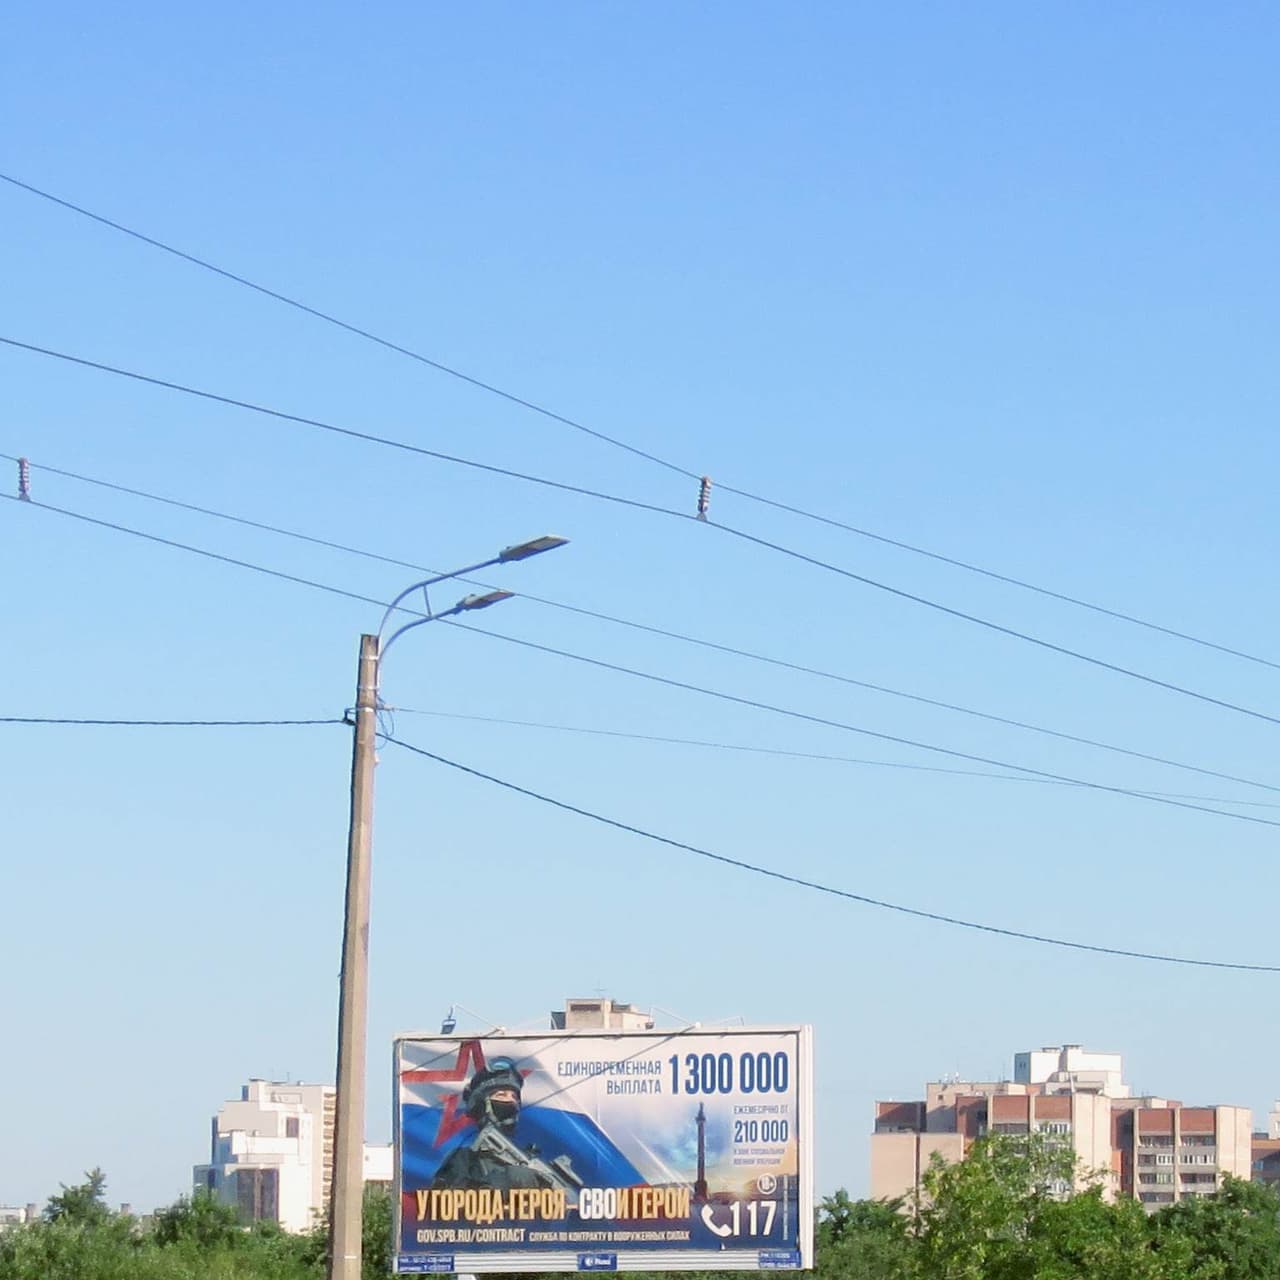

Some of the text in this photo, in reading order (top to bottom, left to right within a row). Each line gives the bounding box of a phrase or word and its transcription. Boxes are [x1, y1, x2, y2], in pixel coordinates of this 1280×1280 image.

[558, 1061, 661, 1076] ЕДИНОВРЕМЕННАЯ
[607, 1080, 661, 1095] ВЫПЛАТА
[735, 1120, 788, 1143] 210 000
[431, 1188, 565, 1224] ГОРОДА-ГЕРОЯ
[580, 1188, 629, 1219] СВОИ
[632, 1187, 690, 1219] ГЕРОИ
[730, 1201, 776, 1236] 117
[417, 1229, 526, 1242] GOV.SPB.RU/CONTRACT
